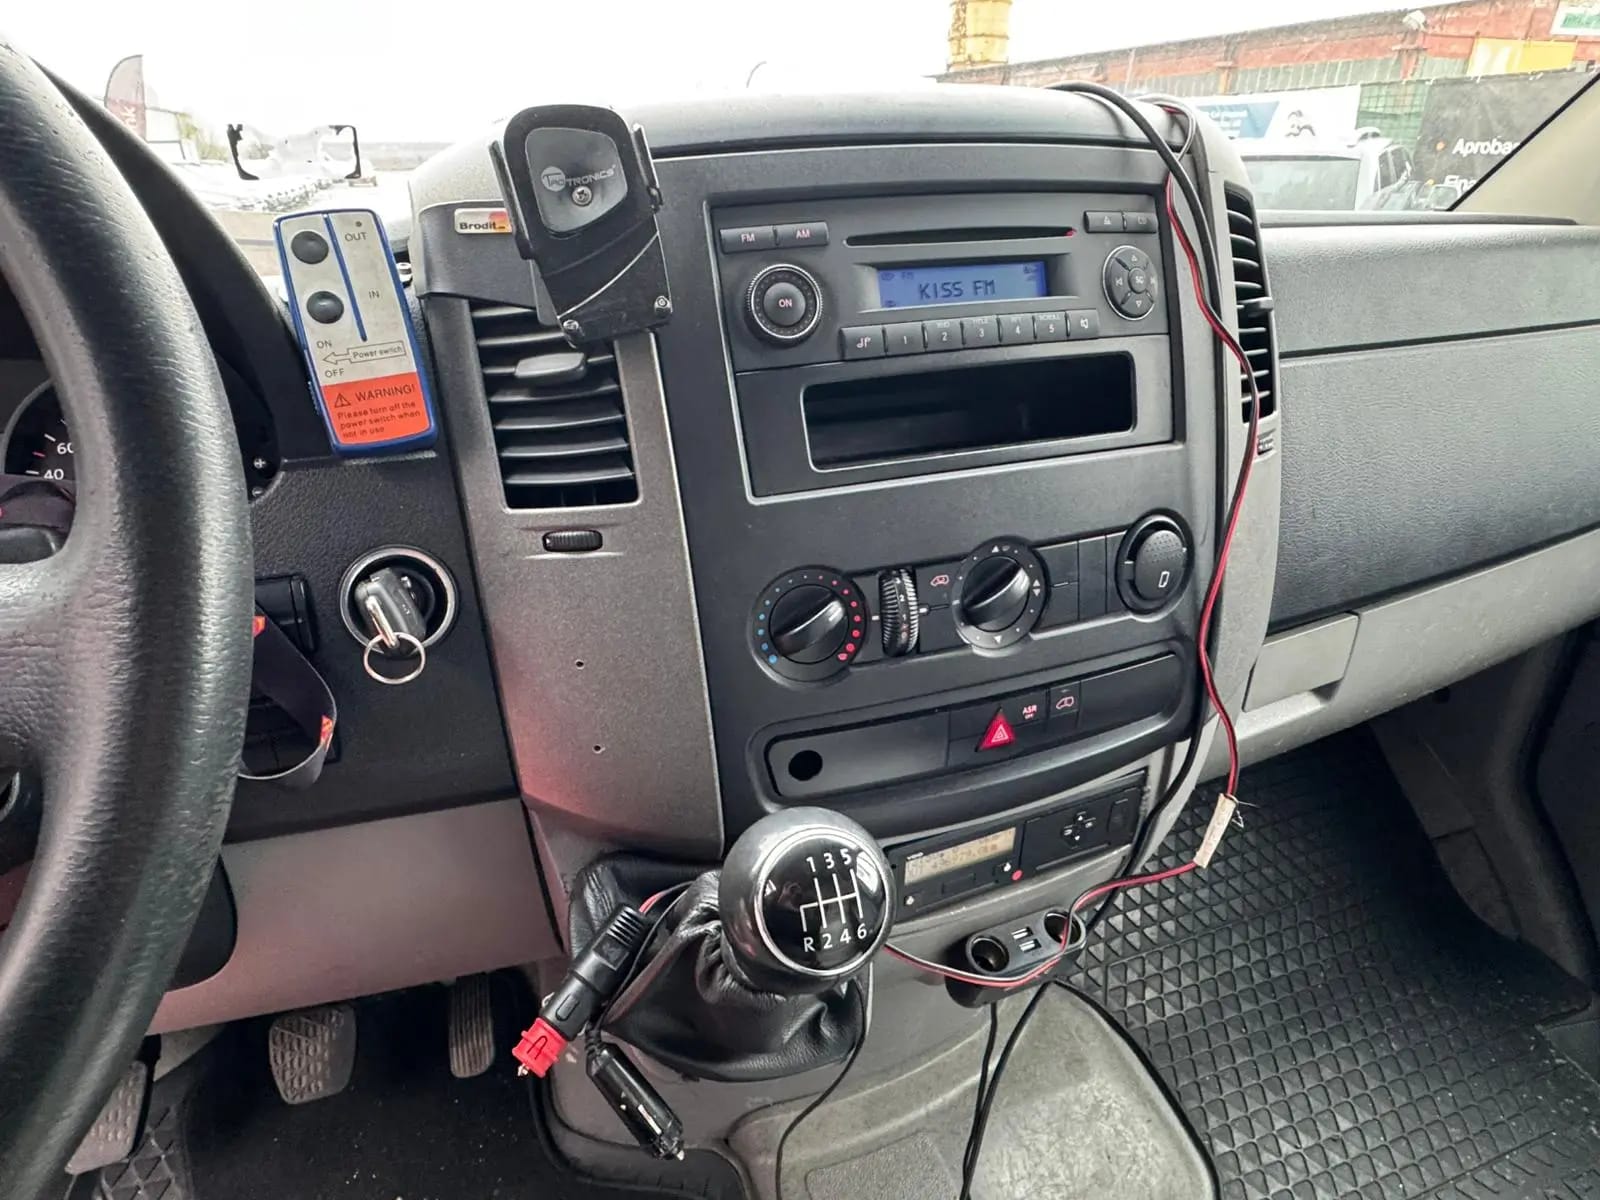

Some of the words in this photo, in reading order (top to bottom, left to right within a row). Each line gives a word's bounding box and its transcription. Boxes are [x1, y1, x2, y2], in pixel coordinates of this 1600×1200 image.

[459, 222, 496, 230] Brodit
[344, 232, 368, 242] OUT
[741, 233, 755, 243] FM
[796, 229, 811, 239] AM
[368, 290, 380, 299] IN
[919, 280, 964, 300] KISS
[973, 279, 996, 296] FM
[778, 298, 793, 308] ON
[316, 339, 332, 349] ON
[353, 350, 377, 359] Power
[380, 346, 403, 355] switch
[324, 368, 345, 378] OFF
[355, 384, 415, 402] WARNING!
[337, 410, 369, 420] Please
[370, 406, 388, 415] turn
[390, 402, 400, 412] off
[401, 401, 416, 410] the
[340, 419, 367, 430] power
[369, 413, 396, 425] switch
[399, 410, 421, 420] when
[343, 431, 357, 439] not
[369, 427, 385, 435] use
[43, 468, 64, 480] 40
[1022, 704, 1037, 716] ASR
[806, 856, 817, 873] 1
[823, 852, 835, 870] 3
[840, 848, 853, 866] 5
[803, 937, 815, 953] R
[822, 933, 833, 950] 2
[839, 928, 852, 945] 4
[857, 923, 867, 940] 6
